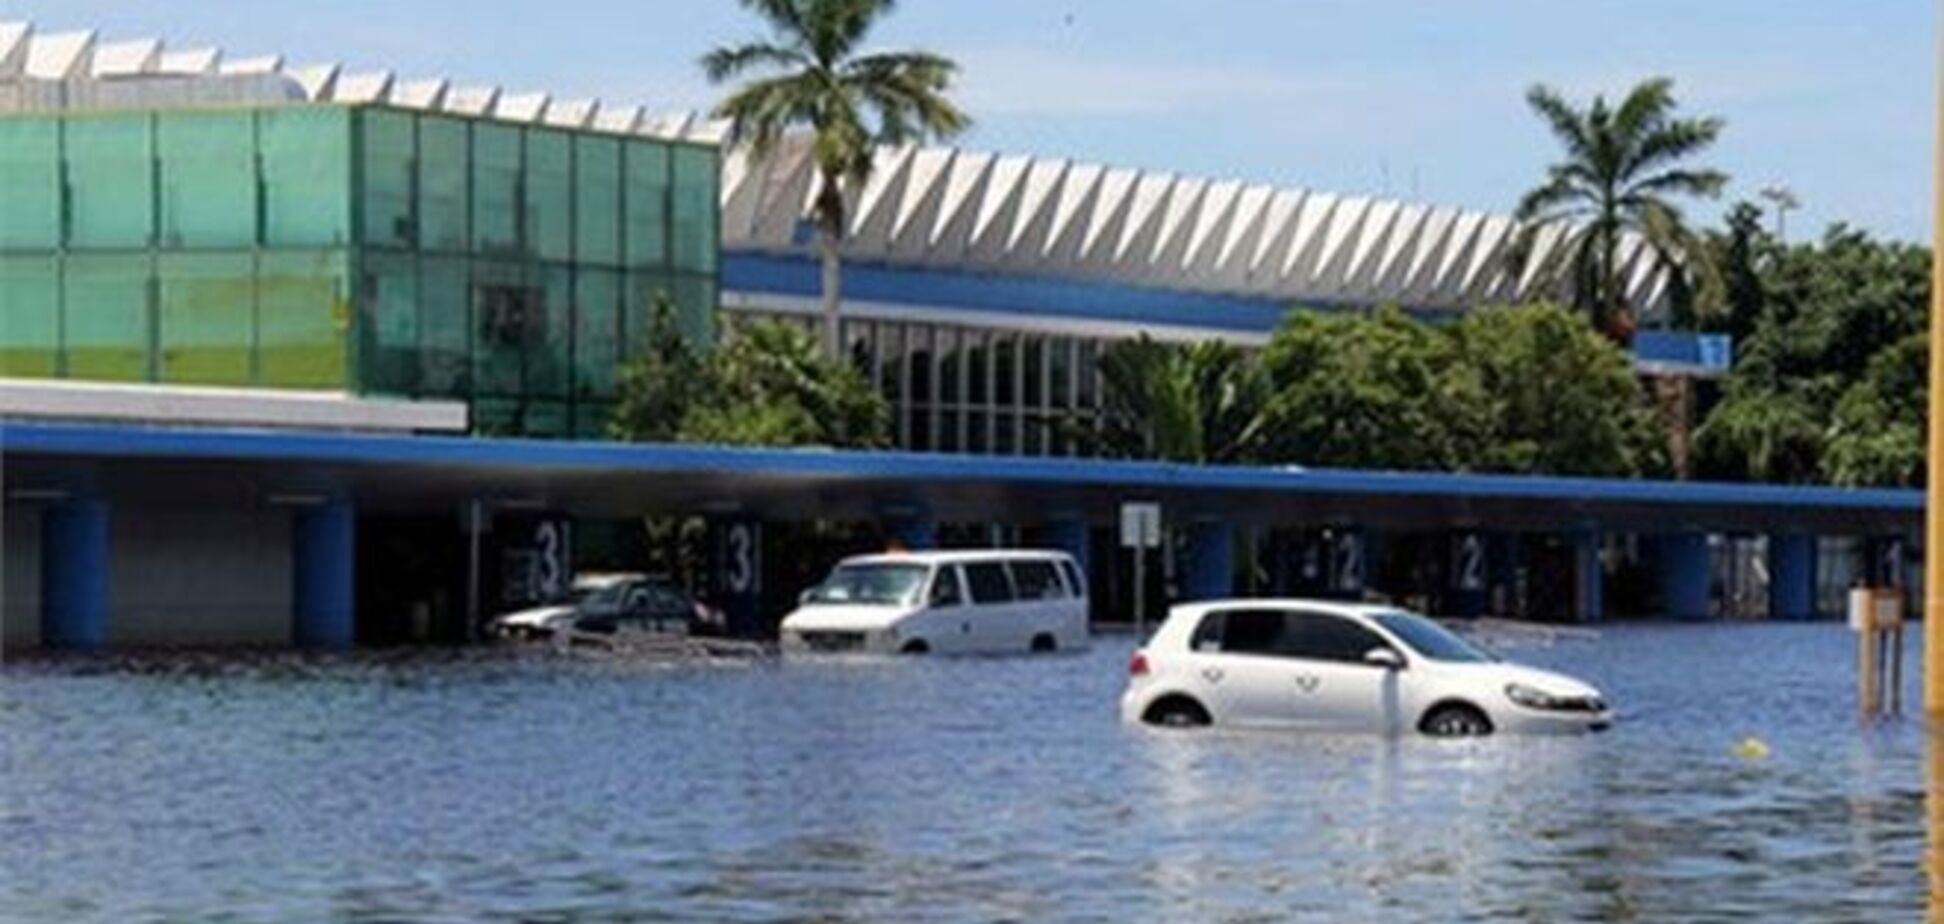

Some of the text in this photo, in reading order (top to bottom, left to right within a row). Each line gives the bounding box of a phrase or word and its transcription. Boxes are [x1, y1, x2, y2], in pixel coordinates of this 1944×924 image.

[536, 521, 560, 595] 3
[730, 523, 752, 592] 3
[1338, 533, 1360, 589] 2
[1461, 534, 1482, 589] 2
